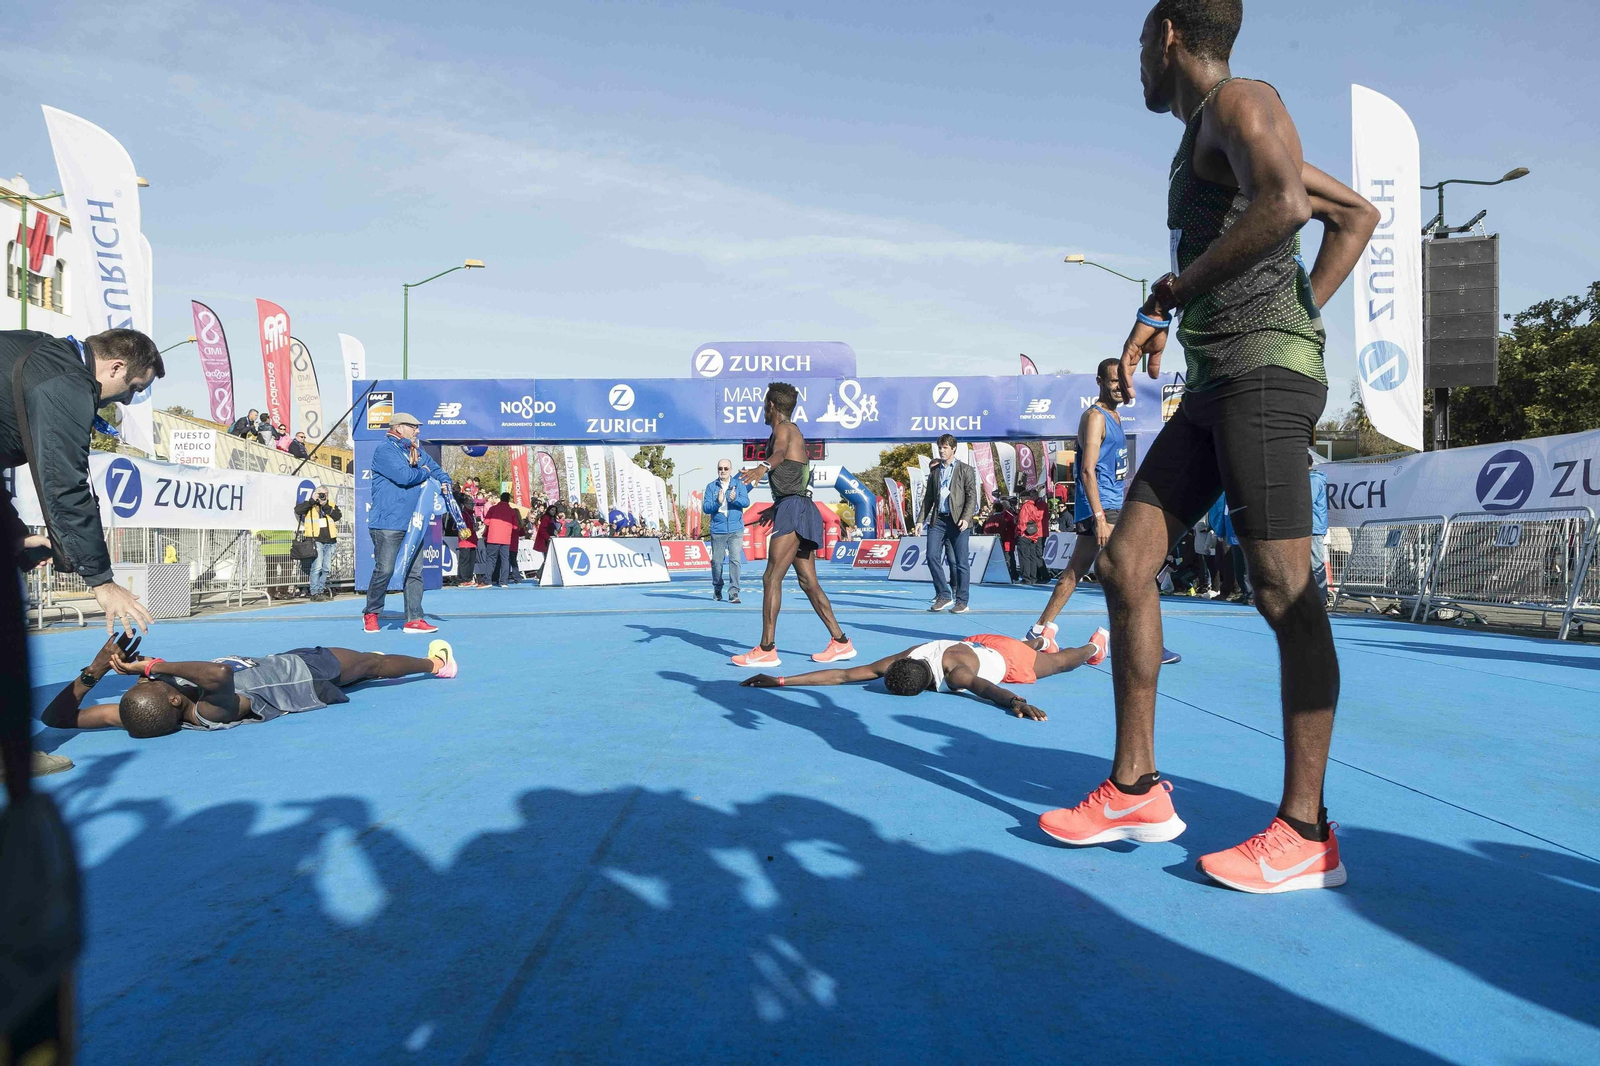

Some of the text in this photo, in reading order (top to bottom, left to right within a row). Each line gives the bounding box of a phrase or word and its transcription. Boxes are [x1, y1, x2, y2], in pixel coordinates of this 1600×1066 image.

[728, 355, 811, 372] ZURICH
[724, 386, 807, 402] MARN
[723, 406, 809, 423] SEVA
[586, 418, 657, 433] ZURICH
[910, 415, 982, 431] ZURICH
[173, 431, 211, 440] PUESTO
[174, 441, 212, 451] MÉDICO
[179, 456, 210, 465] samu
[154, 477, 244, 512] ZURICH
[1326, 479, 1388, 510] RICH
[595, 551, 653, 569] ZURICH
